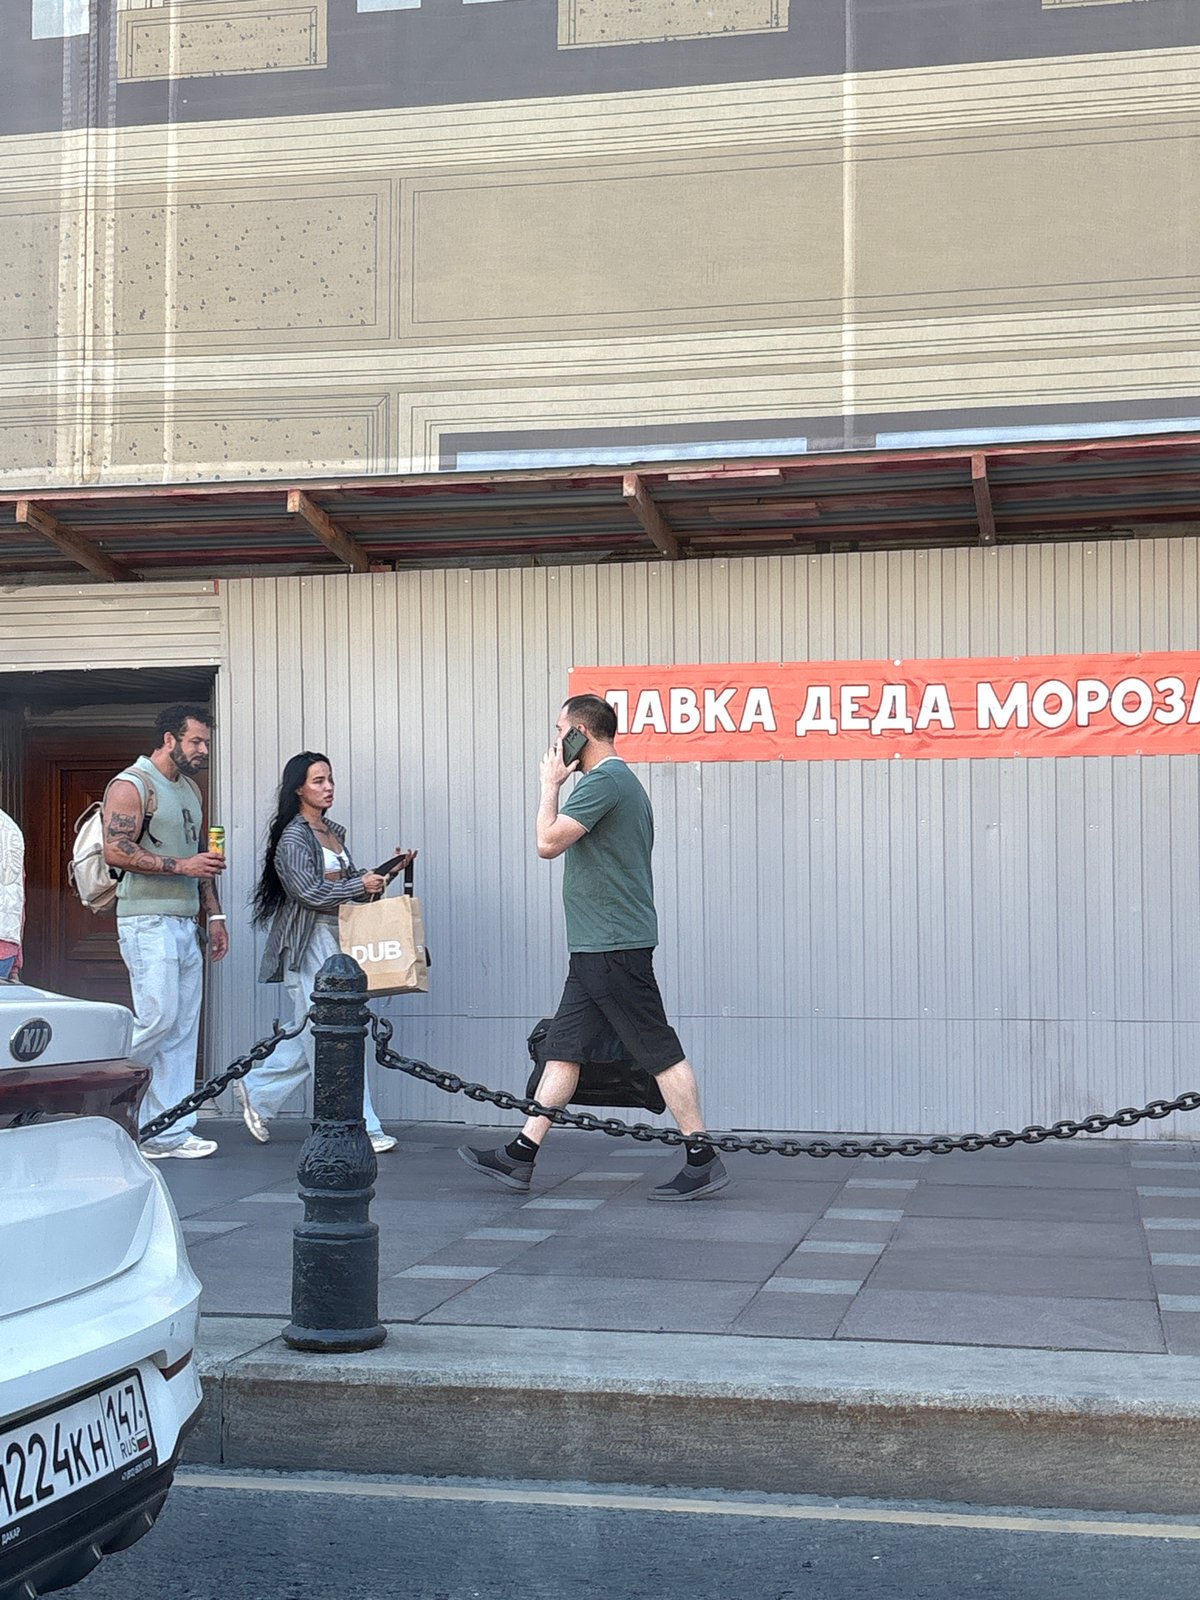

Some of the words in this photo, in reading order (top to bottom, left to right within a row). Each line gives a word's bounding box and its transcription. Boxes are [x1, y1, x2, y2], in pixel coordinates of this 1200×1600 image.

[795, 682, 955, 737] ДЕДА
[351, 940, 402, 964] DUB
[18, 1028, 49, 1054] KIA
[106, 1384, 138, 1442] 147
[119, 1436, 138, 1460] RUS
